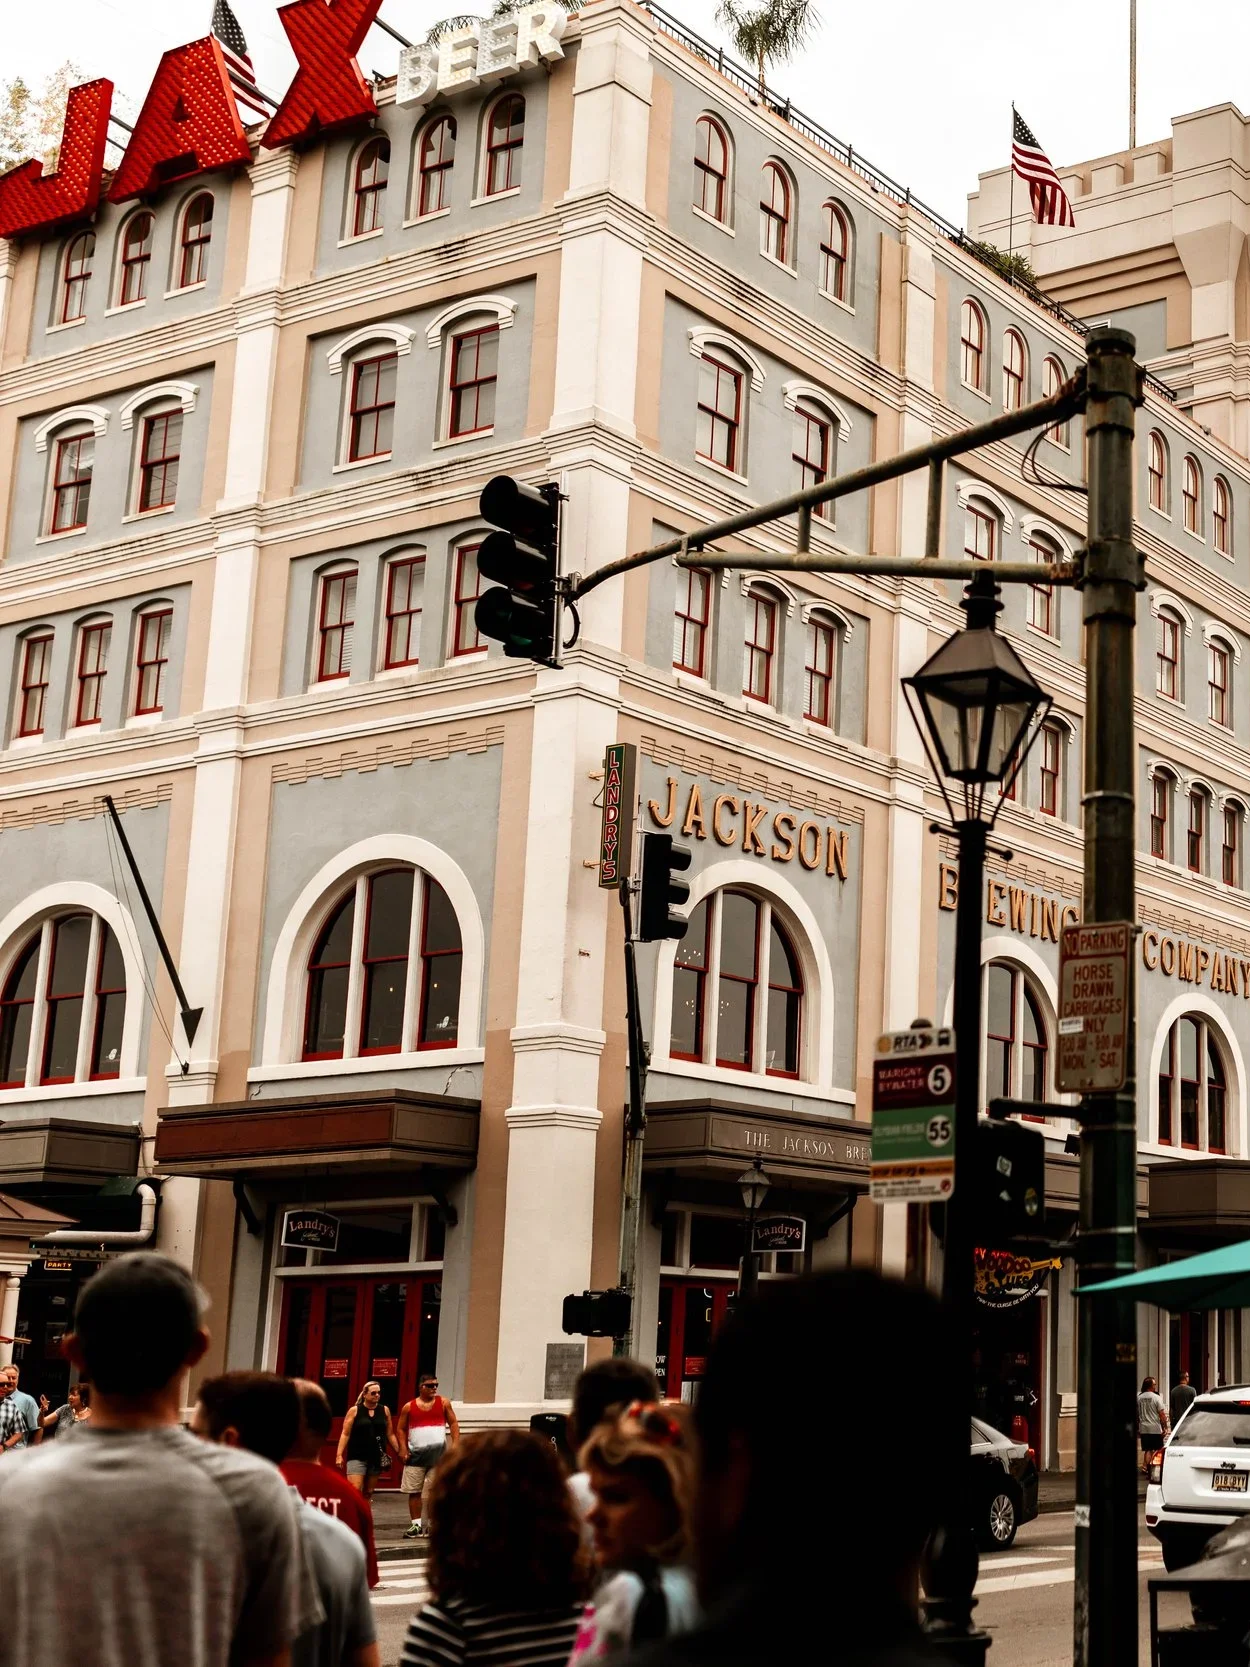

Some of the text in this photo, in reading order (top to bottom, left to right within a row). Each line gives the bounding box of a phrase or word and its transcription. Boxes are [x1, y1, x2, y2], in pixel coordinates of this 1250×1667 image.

[395, 0, 568, 109] BEER
[0, 0, 383, 238] JAX
[648, 776, 850, 881] JACKSON
[1063, 930, 1124, 956] NO PARKING
[1073, 964, 1114, 981] HORSE
[1073, 982, 1114, 999] DRAWN
[1083, 1017, 1107, 1033] NLY
[893, 1034, 917, 1049] RTA
[932, 1067, 945, 1092] 5
[929, 1120, 951, 1141] 55
[744, 1130, 771, 1148] THE
[783, 1136, 835, 1156] JACKSON
[289, 1218, 336, 1238] Landry's
[757, 1223, 801, 1240] Landry's
[1220, 1461, 1236, 1469] Jeep
